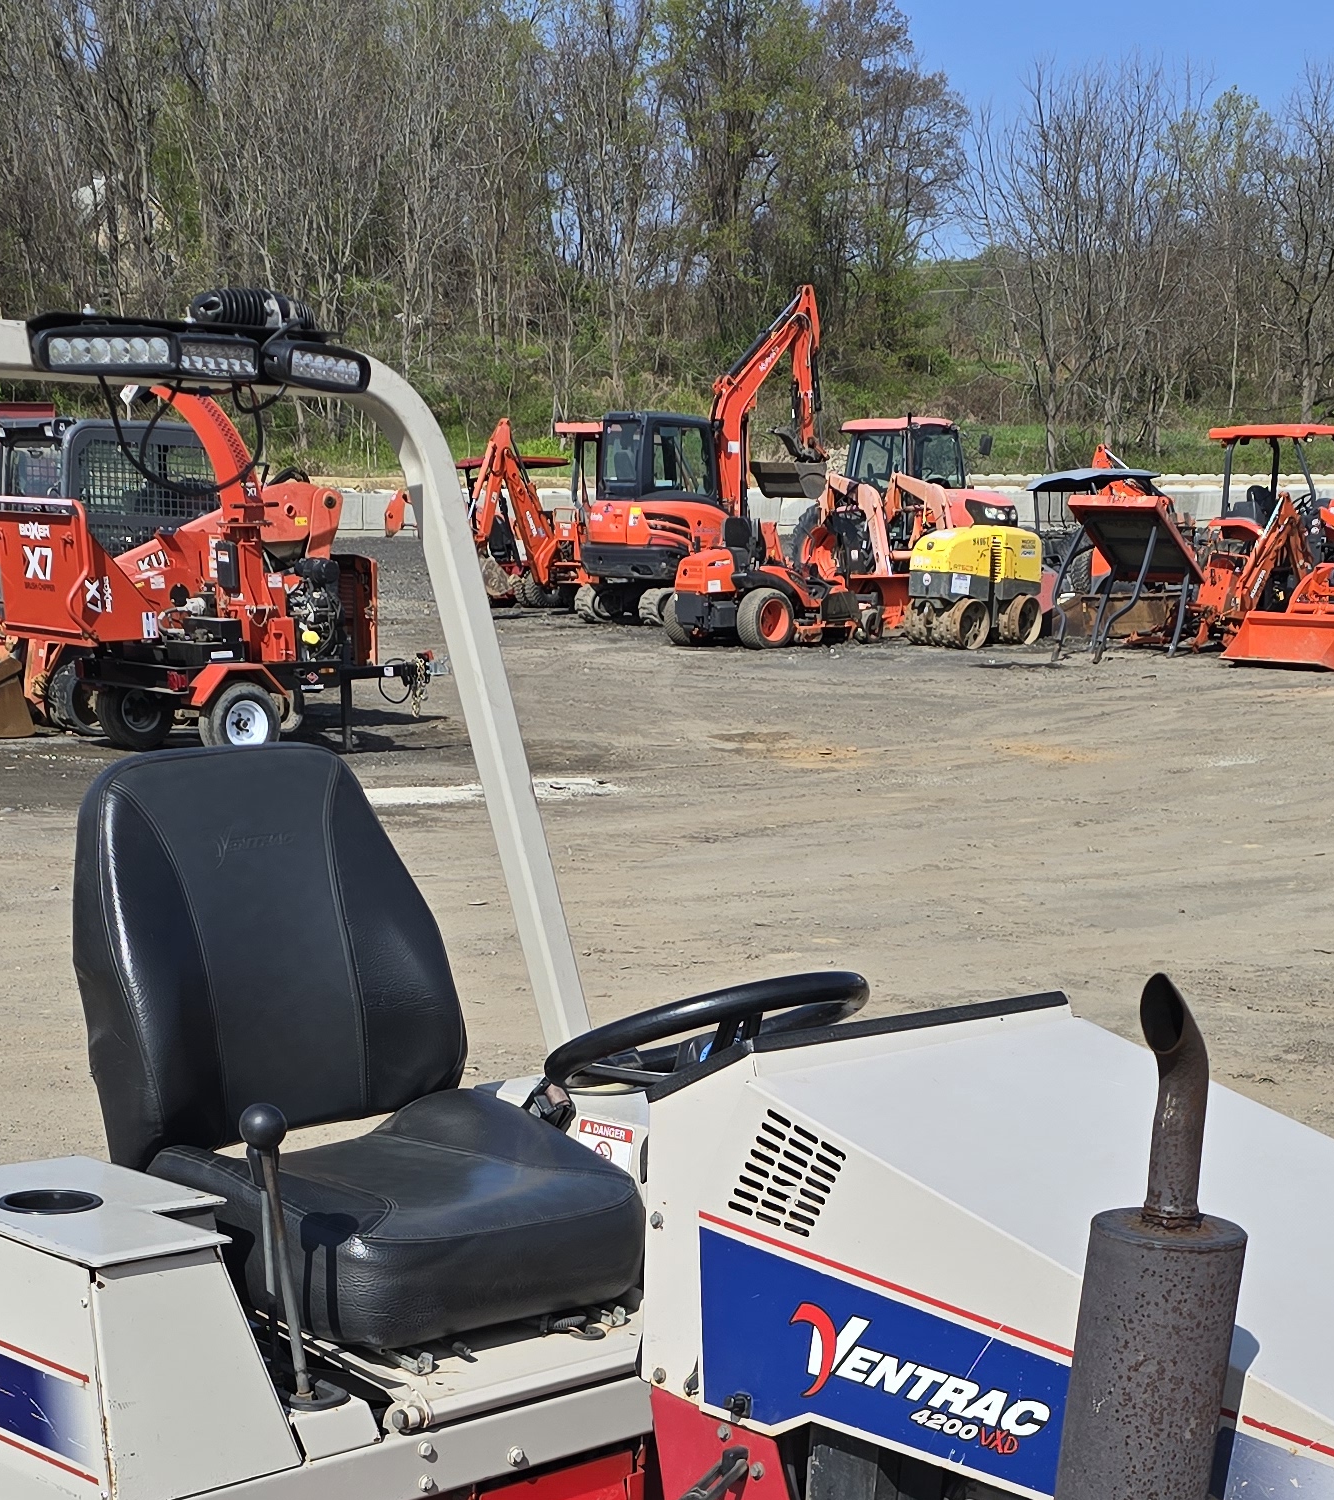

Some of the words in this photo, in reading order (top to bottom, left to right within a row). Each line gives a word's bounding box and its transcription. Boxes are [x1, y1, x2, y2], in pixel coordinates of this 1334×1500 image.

[18, 521, 51, 541] BOXER
[22, 544, 53, 580] X7
[84, 578, 102, 613] X7
[592, 1124, 626, 1141] DANGER
[788, 1302, 1052, 1438] VENTRAC
